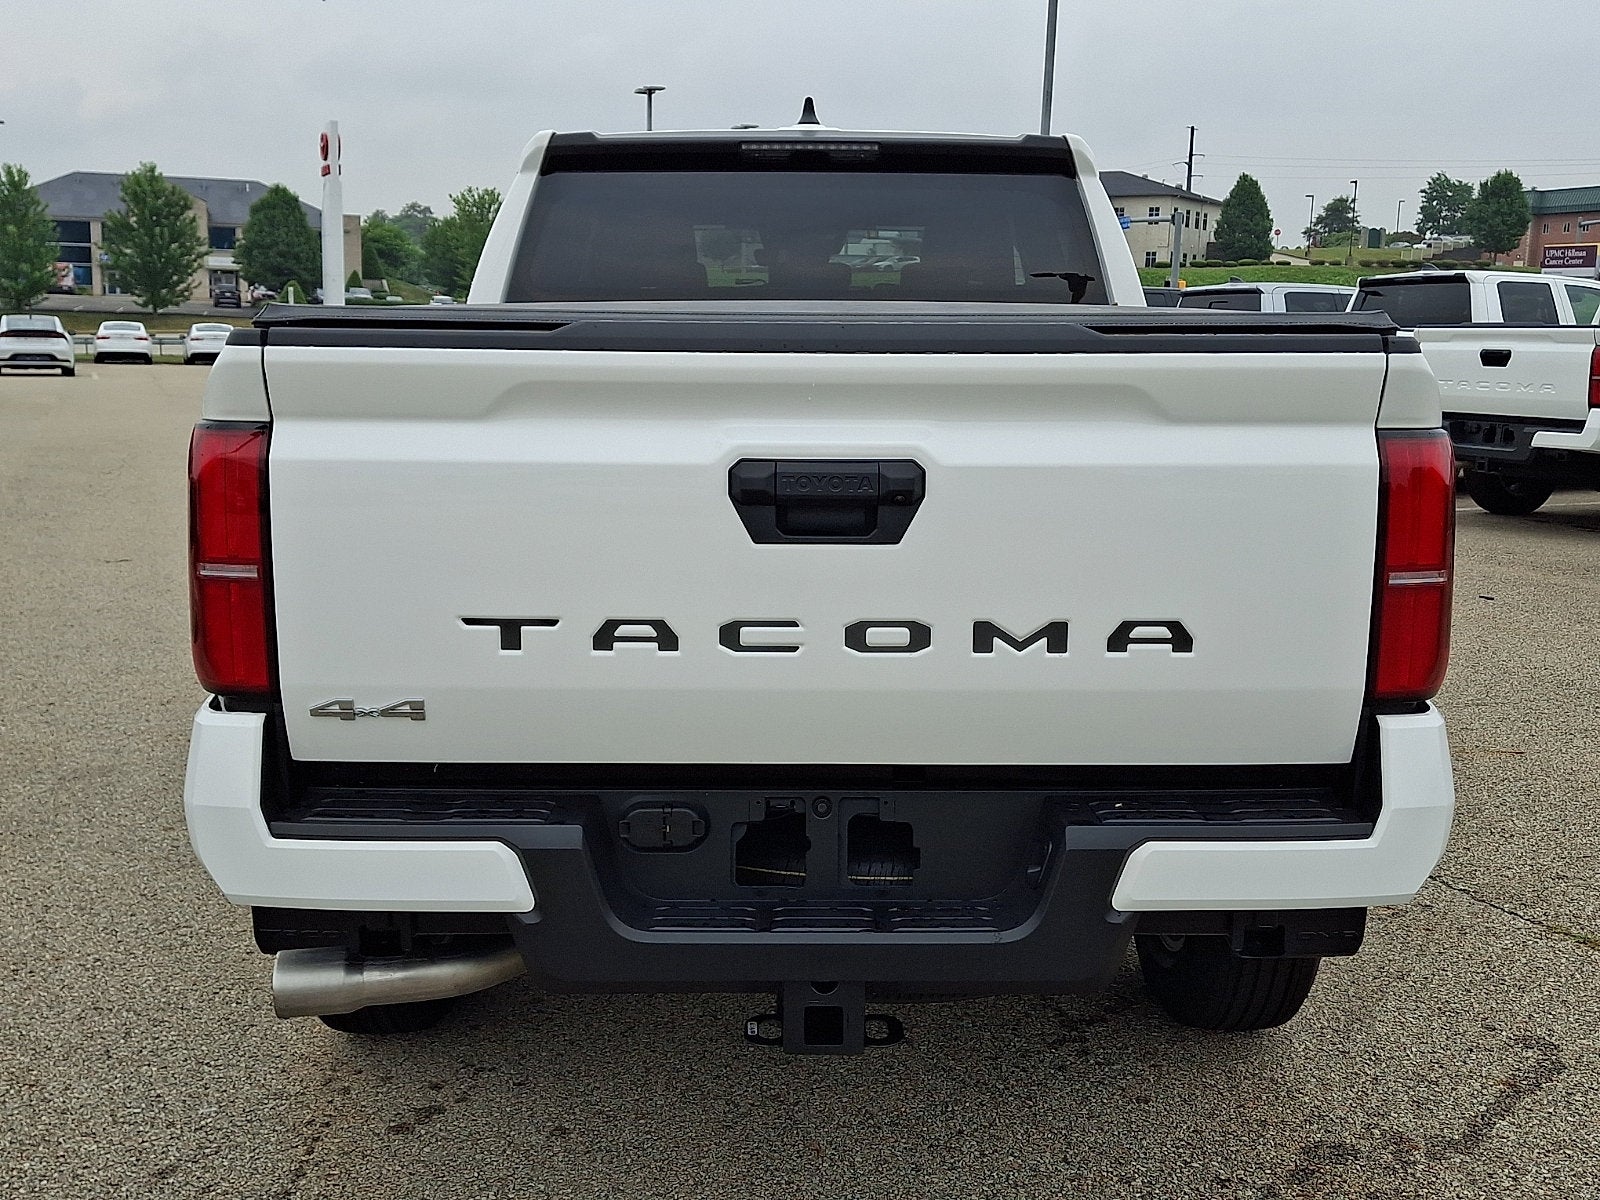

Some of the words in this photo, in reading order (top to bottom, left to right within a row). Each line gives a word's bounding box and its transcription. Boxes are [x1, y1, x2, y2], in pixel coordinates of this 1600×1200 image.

[1545, 249, 1565, 257] UPMC
[1564, 257, 1583, 265] Center
[1438, 379, 1556, 394] TACOMA
[781, 475, 874, 492] TOYOTA
[459, 617, 1194, 654] TACOMA
